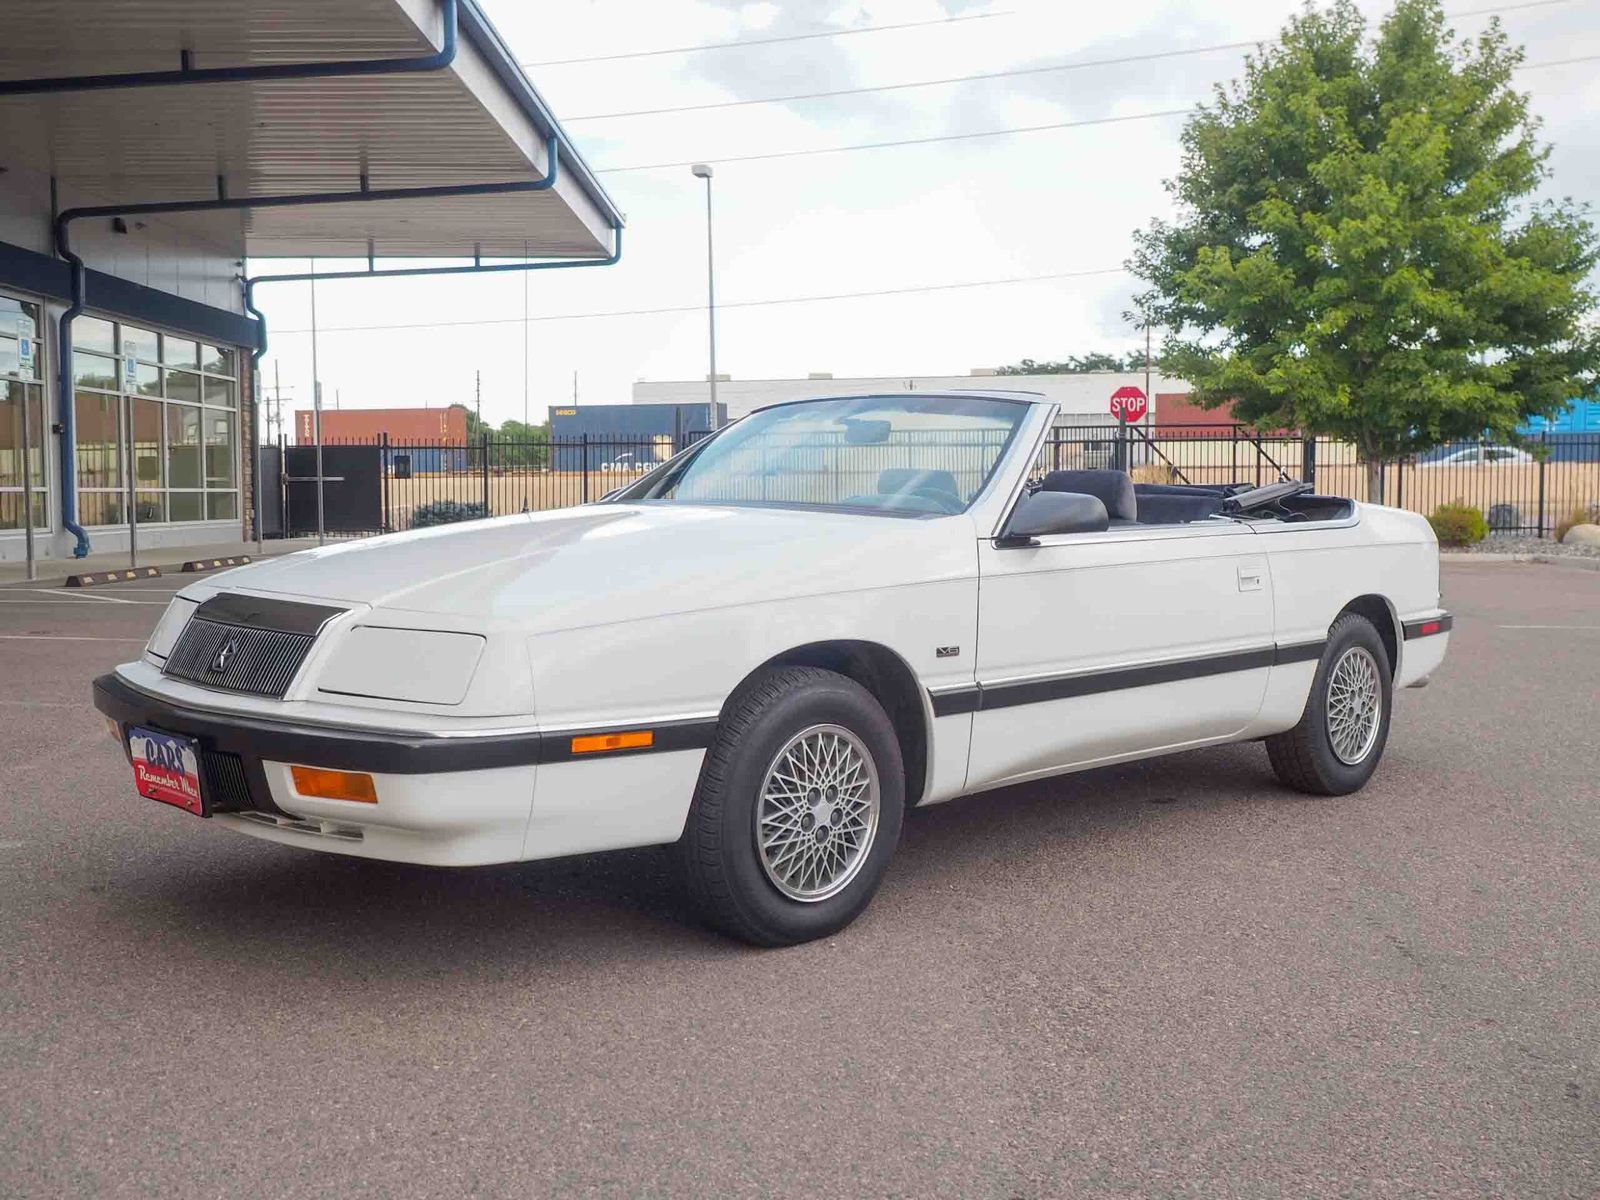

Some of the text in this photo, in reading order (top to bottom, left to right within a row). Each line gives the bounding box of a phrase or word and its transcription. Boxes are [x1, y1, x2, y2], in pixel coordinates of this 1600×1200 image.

[1112, 397, 1146, 412] STOP
[601, 462, 629, 472] CMA
[138, 764, 180, 791] Remember
[180, 777, 198, 796] When
